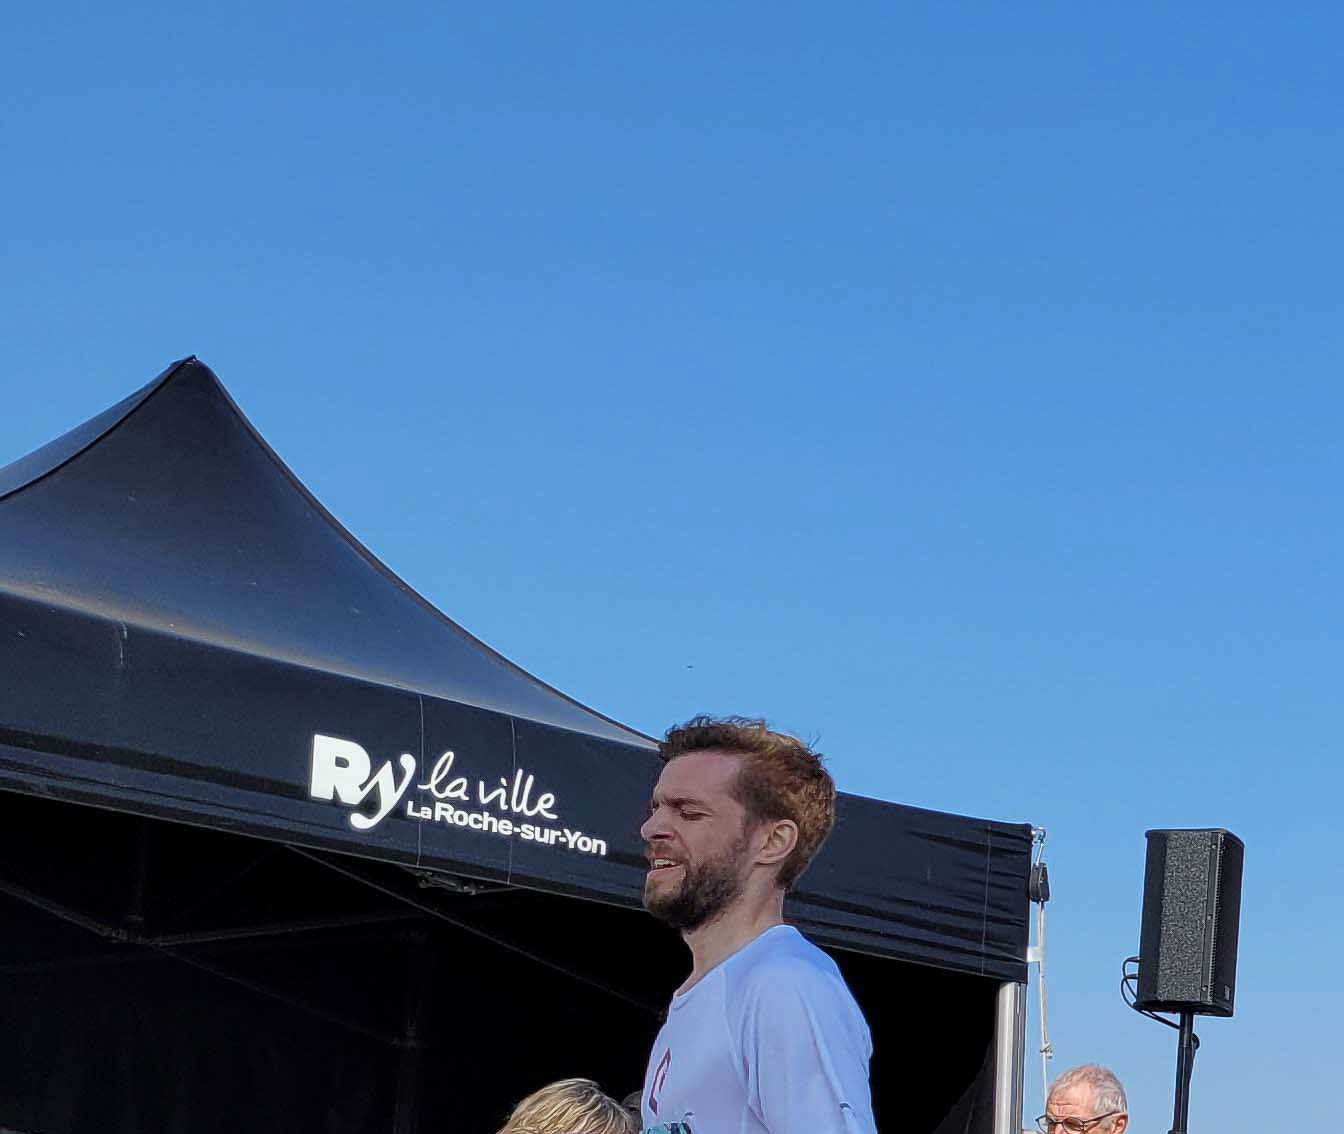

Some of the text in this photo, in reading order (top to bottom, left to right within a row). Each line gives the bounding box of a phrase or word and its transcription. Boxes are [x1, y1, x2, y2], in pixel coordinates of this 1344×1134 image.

[311, 734, 416, 829] Ry
[418, 751, 560, 820] la ville
[406, 800, 607, 856] La Roche-sur-Yon
